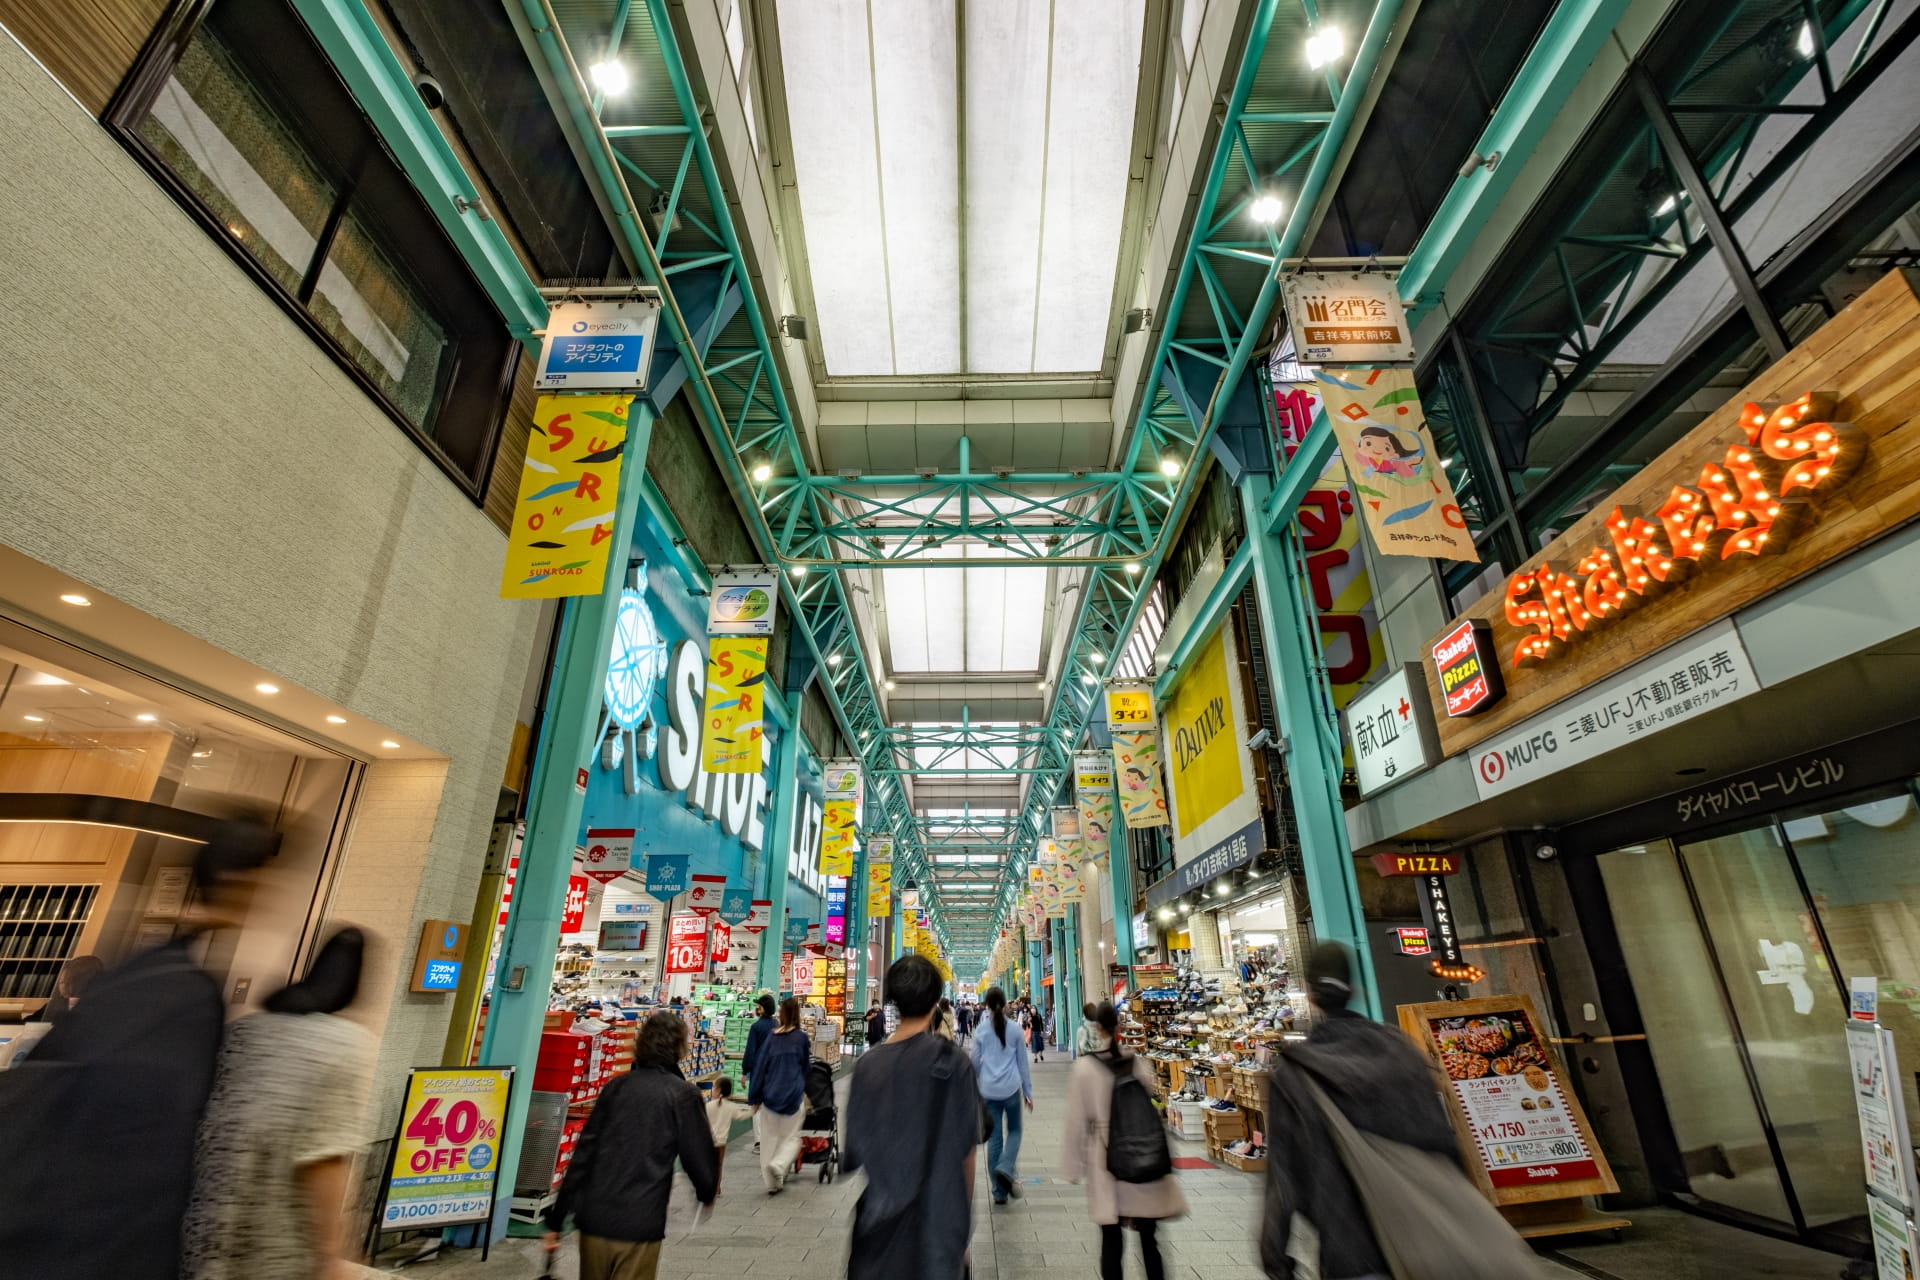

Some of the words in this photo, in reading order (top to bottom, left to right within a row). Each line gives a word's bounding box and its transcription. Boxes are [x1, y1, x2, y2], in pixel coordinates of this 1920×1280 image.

[1329, 299, 1388, 317] 名門会
[590, 323, 629, 333] eyecity
[1312, 330, 1393, 342] 吉祥寺駅前校
[567, 344, 625, 353] コンタクトの
[564, 352, 622, 363] アイシティ
[1267, 389, 1371, 687] 靴ダイワ
[1505, 391, 1840, 669] Shakey's
[529, 568, 583, 577] SUNROAD
[1566, 651, 1735, 743] 三菱UFJ不動産販売
[1114, 709, 1150, 720] ダイワ
[1627, 678, 1739, 735] 三菱UFJ信託銀行グループ
[1354, 703, 1400, 760] 献血
[1505, 731, 1558, 771] MUFG
[1678, 758, 1844, 822] ダイヤバローレビル
[1397, 857, 1452, 872] PIZZA
[1430, 876, 1456, 960] SHAKEYS
[431, 964, 456, 974] コンタクトの
[689, 960, 704, 968] OFF
[428, 972, 454, 984] アイシティ
[1468, 1078, 1517, 1089] ランチバイキング
[1480, 1121, 1526, 1139] ¥1,750
[1550, 1141, 1577, 1157] ¥800
[410, 1147, 466, 1174] OFF
